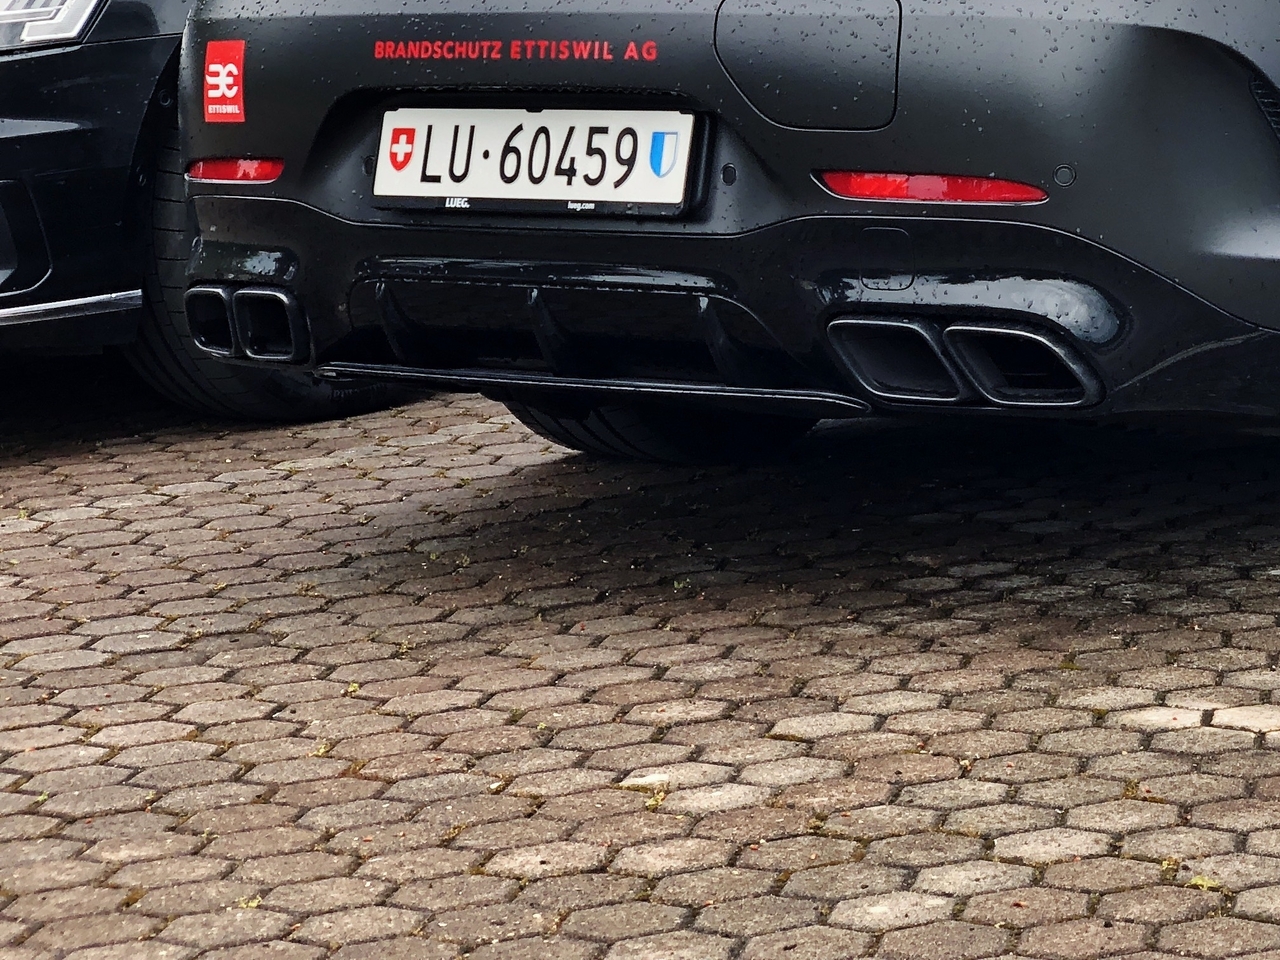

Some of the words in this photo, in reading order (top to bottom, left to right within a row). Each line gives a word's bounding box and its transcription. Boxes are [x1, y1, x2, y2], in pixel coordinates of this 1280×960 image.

[374, 40, 502, 59] BRANDSCHUTZ
[509, 40, 613, 60] ETTISWIL
[623, 41, 658, 61] AG
[567, 200, 595, 211] lueg.com
